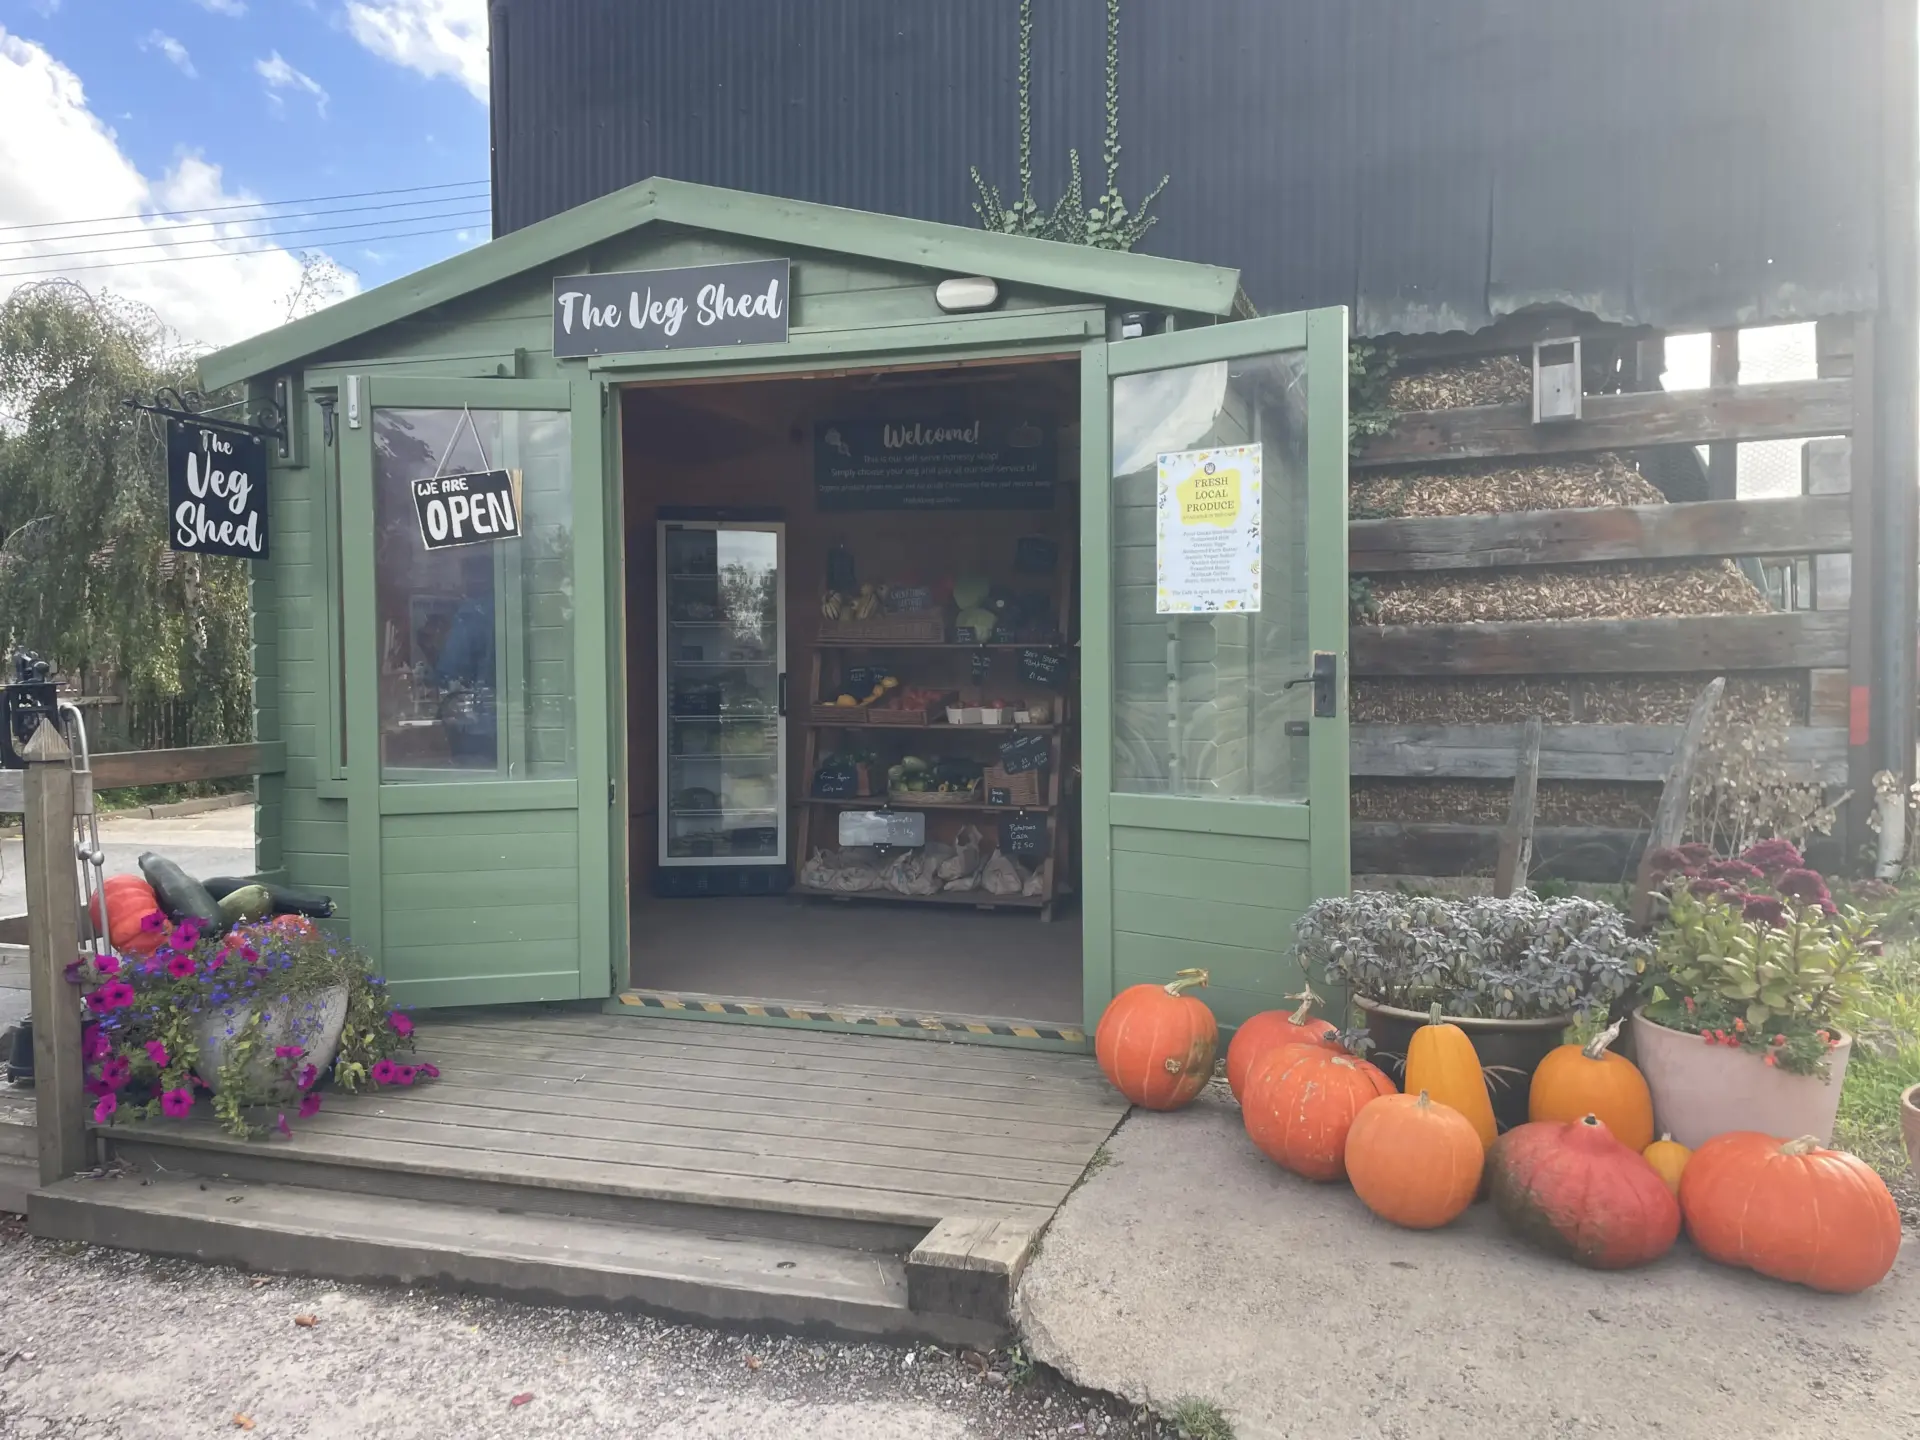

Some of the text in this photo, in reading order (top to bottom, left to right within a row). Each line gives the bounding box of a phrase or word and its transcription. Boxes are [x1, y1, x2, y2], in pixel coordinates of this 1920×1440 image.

[558, 278, 782, 337] The Veg Shed
[199, 428, 233, 456] The
[883, 420, 980, 448] Welcome!
[864, 455, 879, 464] This
[942, 452, 975, 463] honesty
[187, 451, 253, 515] Veg
[831, 468, 856, 479] Simply
[857, 467, 885, 476] choose
[886, 468, 903, 477] your
[1194, 476, 1229, 488] FRESH
[417, 478, 469, 497] WE ARE
[1195, 489, 1229, 500] LOCAL
[427, 491, 516, 540] OPEN
[1186, 500, 1235, 513] PRODUCE
[176, 500, 264, 554] Shed
